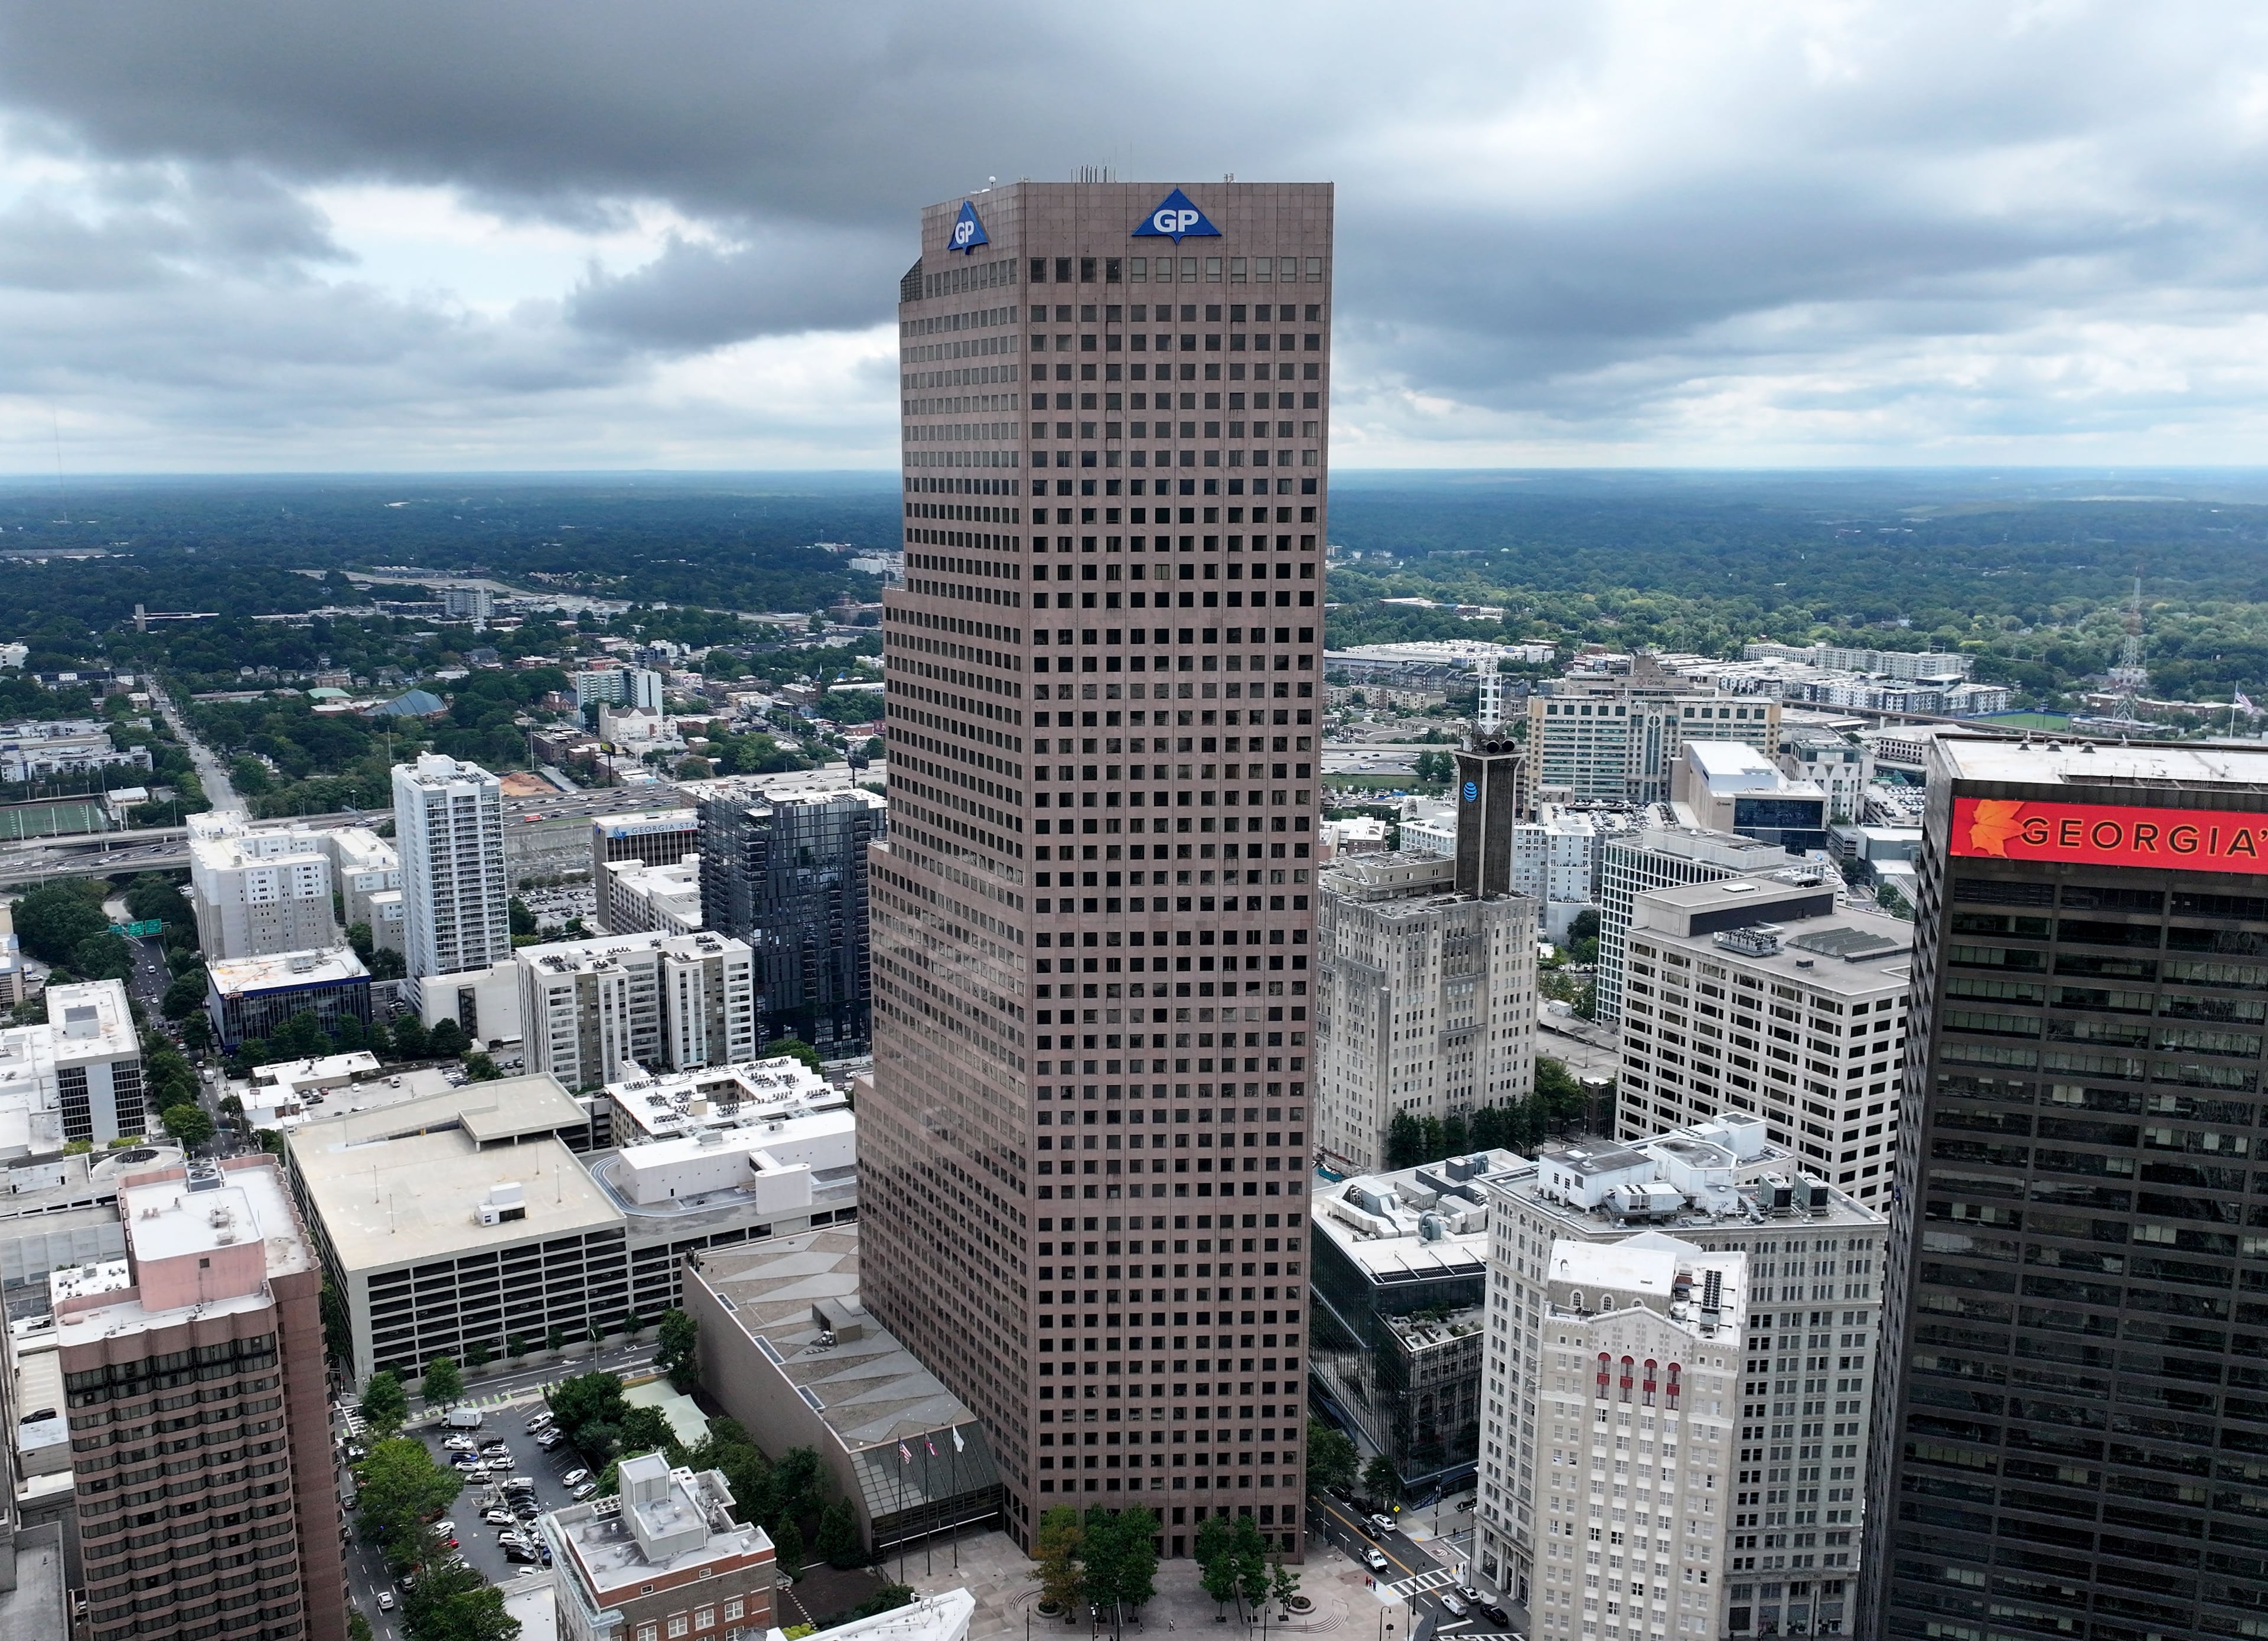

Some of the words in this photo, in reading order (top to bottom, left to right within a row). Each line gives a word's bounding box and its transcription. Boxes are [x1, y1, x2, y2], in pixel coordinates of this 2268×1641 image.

[955, 220, 975, 244] GP
[1153, 209, 1199, 232] GP
[632, 824, 675, 834] GEORGIA
[680, 821, 698, 829] STA
